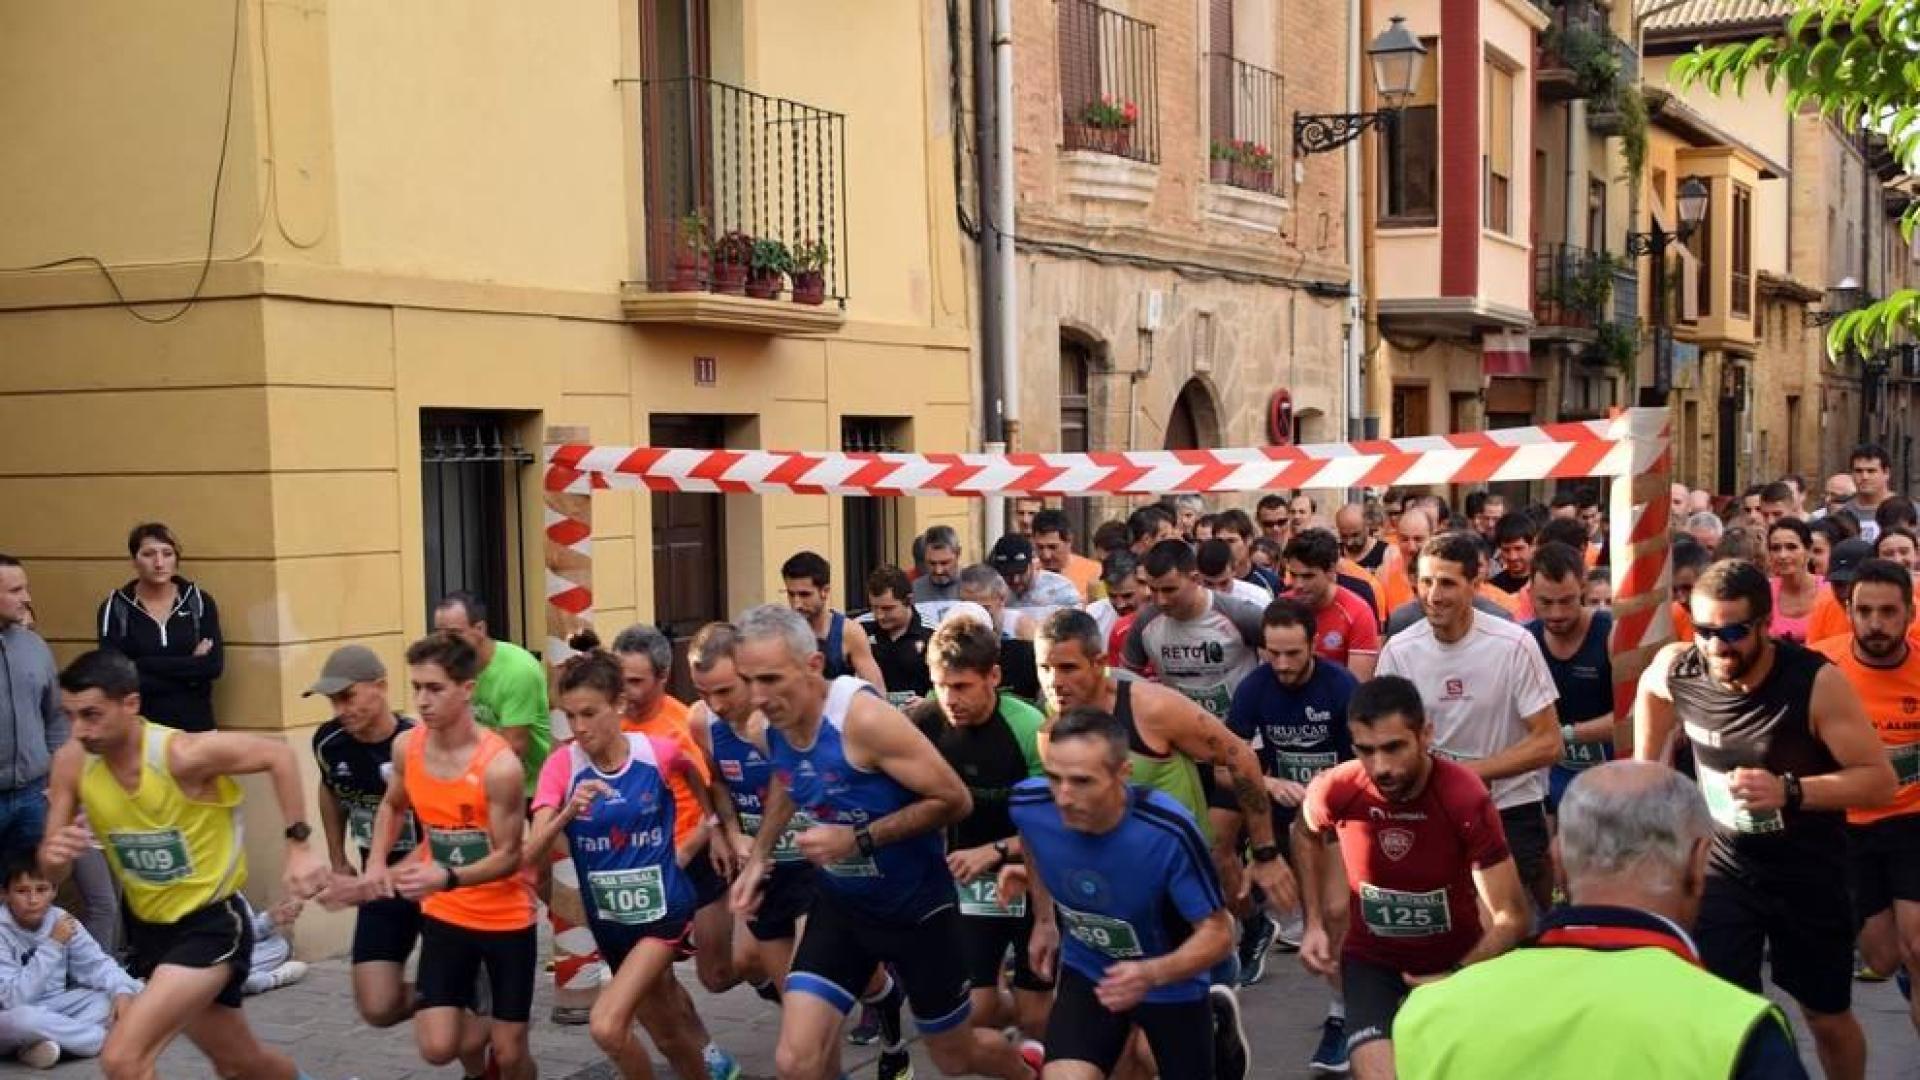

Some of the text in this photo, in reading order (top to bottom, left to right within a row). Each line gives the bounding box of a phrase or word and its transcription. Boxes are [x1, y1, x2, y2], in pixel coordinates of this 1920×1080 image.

[699, 360, 713, 381] 11
[127, 849, 174, 870] 109
[450, 847, 464, 863] 4
[604, 888, 651, 910] 106
[1377, 907, 1431, 926] 125
